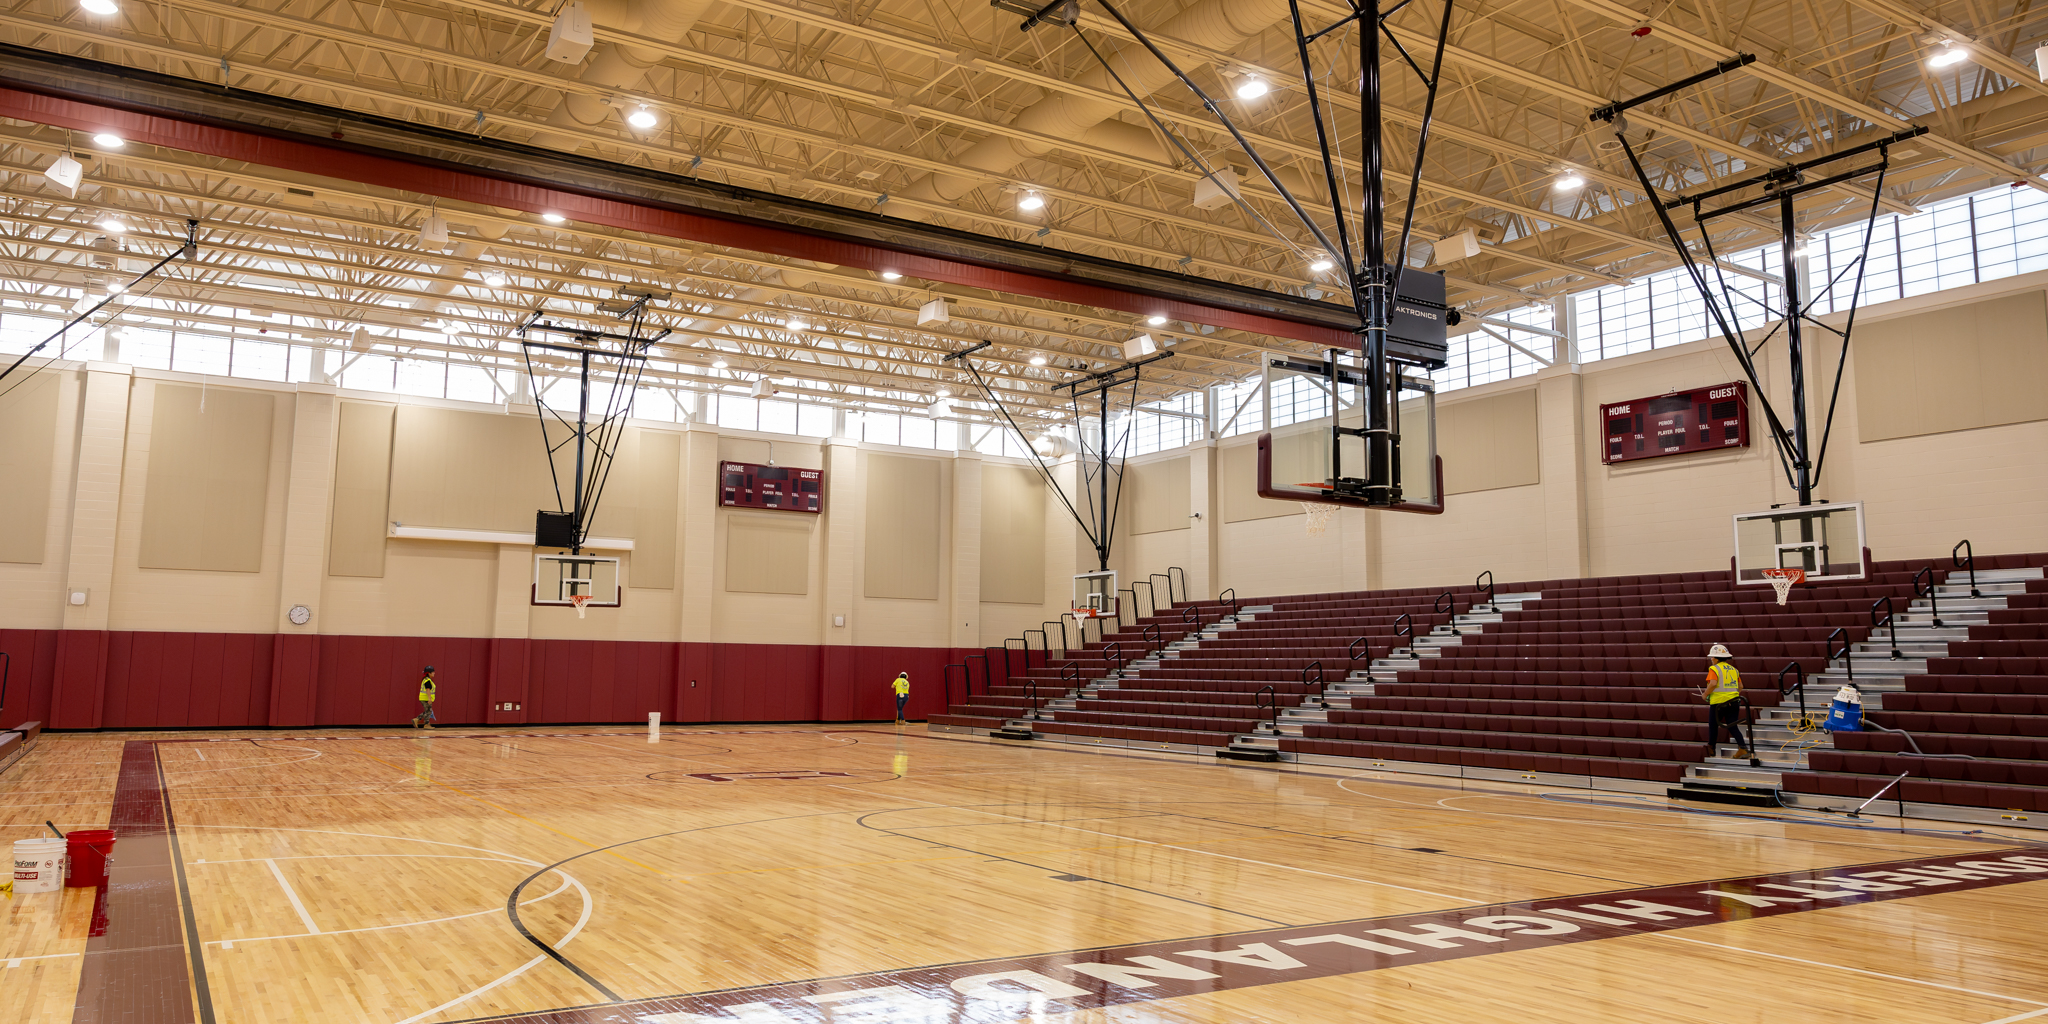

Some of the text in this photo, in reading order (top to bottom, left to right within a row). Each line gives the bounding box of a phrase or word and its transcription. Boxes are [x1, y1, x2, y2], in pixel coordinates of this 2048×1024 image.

[1709, 386, 1737, 399] GUEST
[1609, 405, 1631, 416] HOME
[1658, 419, 1674, 427] PERIOD
[1723, 419, 1738, 427] FOULS
[727, 464, 744, 473] HOME
[800, 471, 819, 479] GUEST
